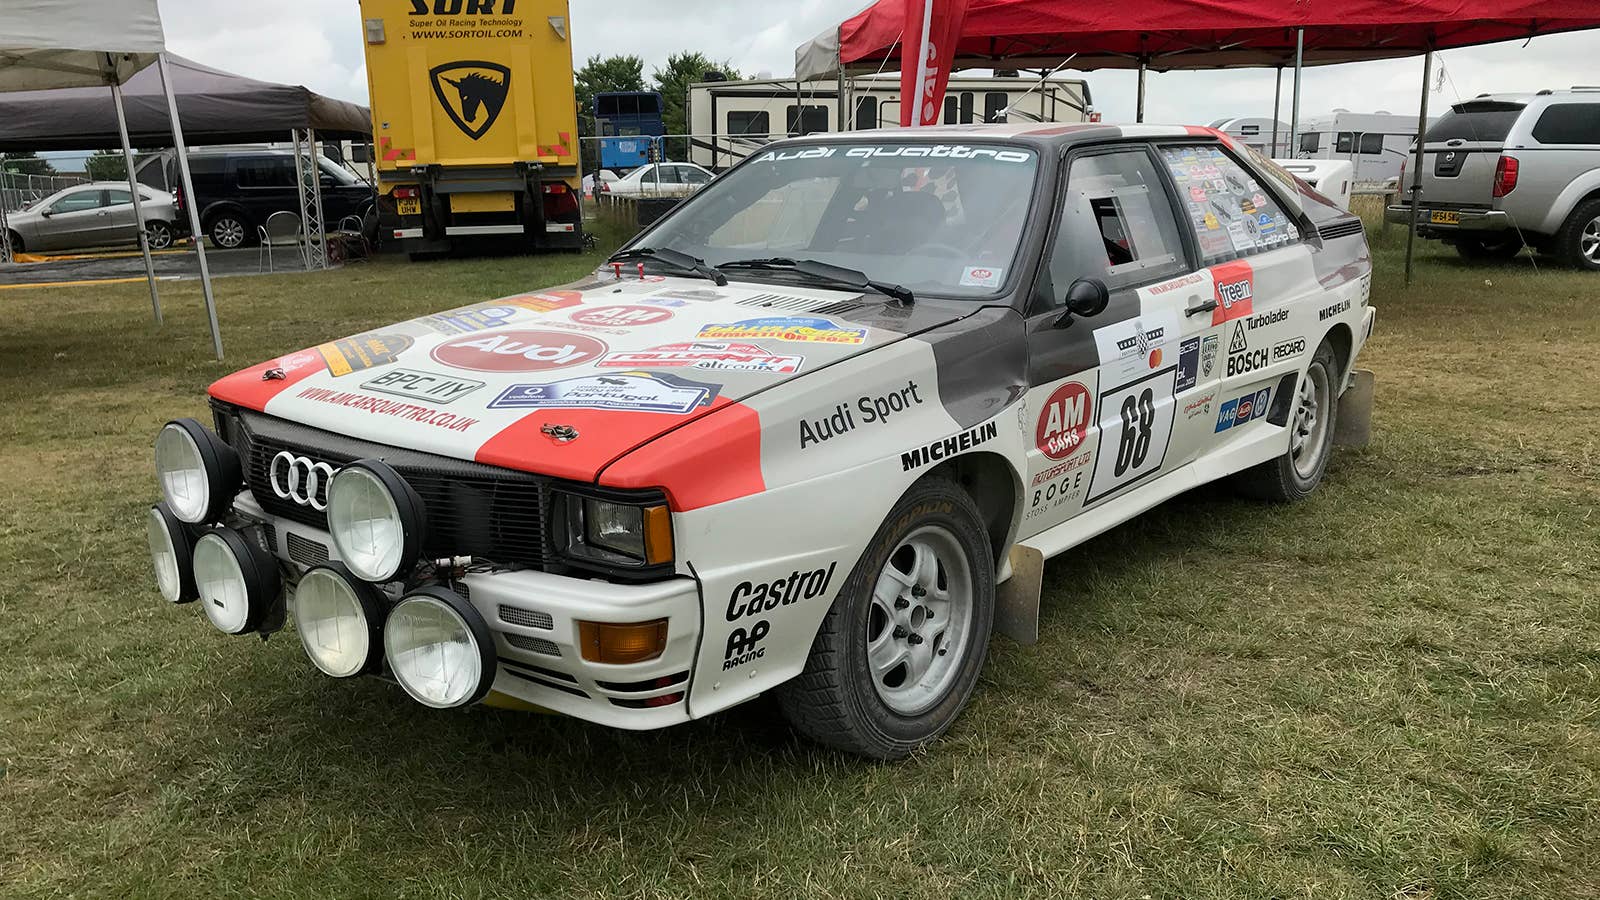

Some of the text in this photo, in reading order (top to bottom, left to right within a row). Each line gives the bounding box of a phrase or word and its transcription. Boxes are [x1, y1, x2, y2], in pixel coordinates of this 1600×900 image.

[409, 19, 524, 28] Super Oil Racing Technology
[412, 29, 523, 39] WWW.SORTOIL.COM
[845, 144, 1032, 164] quattro
[1218, 279, 1252, 309] freem
[584, 307, 668, 321] AM
[1246, 309, 1289, 331] Turbolader
[1319, 298, 1351, 322] MICHELIN
[450, 335, 589, 364] Audi
[1227, 347, 1269, 378] BOSCH
[1273, 339, 1306, 360] RECARO
[698, 359, 776, 371] altronix
[371, 372, 436, 390] BPC
[296, 386, 481, 433] WWW.AMCARSQUATTRO.CO.UK
[563, 391, 660, 402] Portugal
[800, 380, 923, 449] Audi Sport
[1043, 391, 1086, 440] AM
[1219, 408, 1236, 424] VAG
[1047, 428, 1080, 455] CARS
[1114, 387, 1156, 478] 68
[901, 421, 998, 472] MICHELIN
[1032, 471, 1083, 507] BOGE
[725, 561, 838, 622] Castrol
[724, 619, 771, 660] AP
[722, 647, 766, 672] RACING
